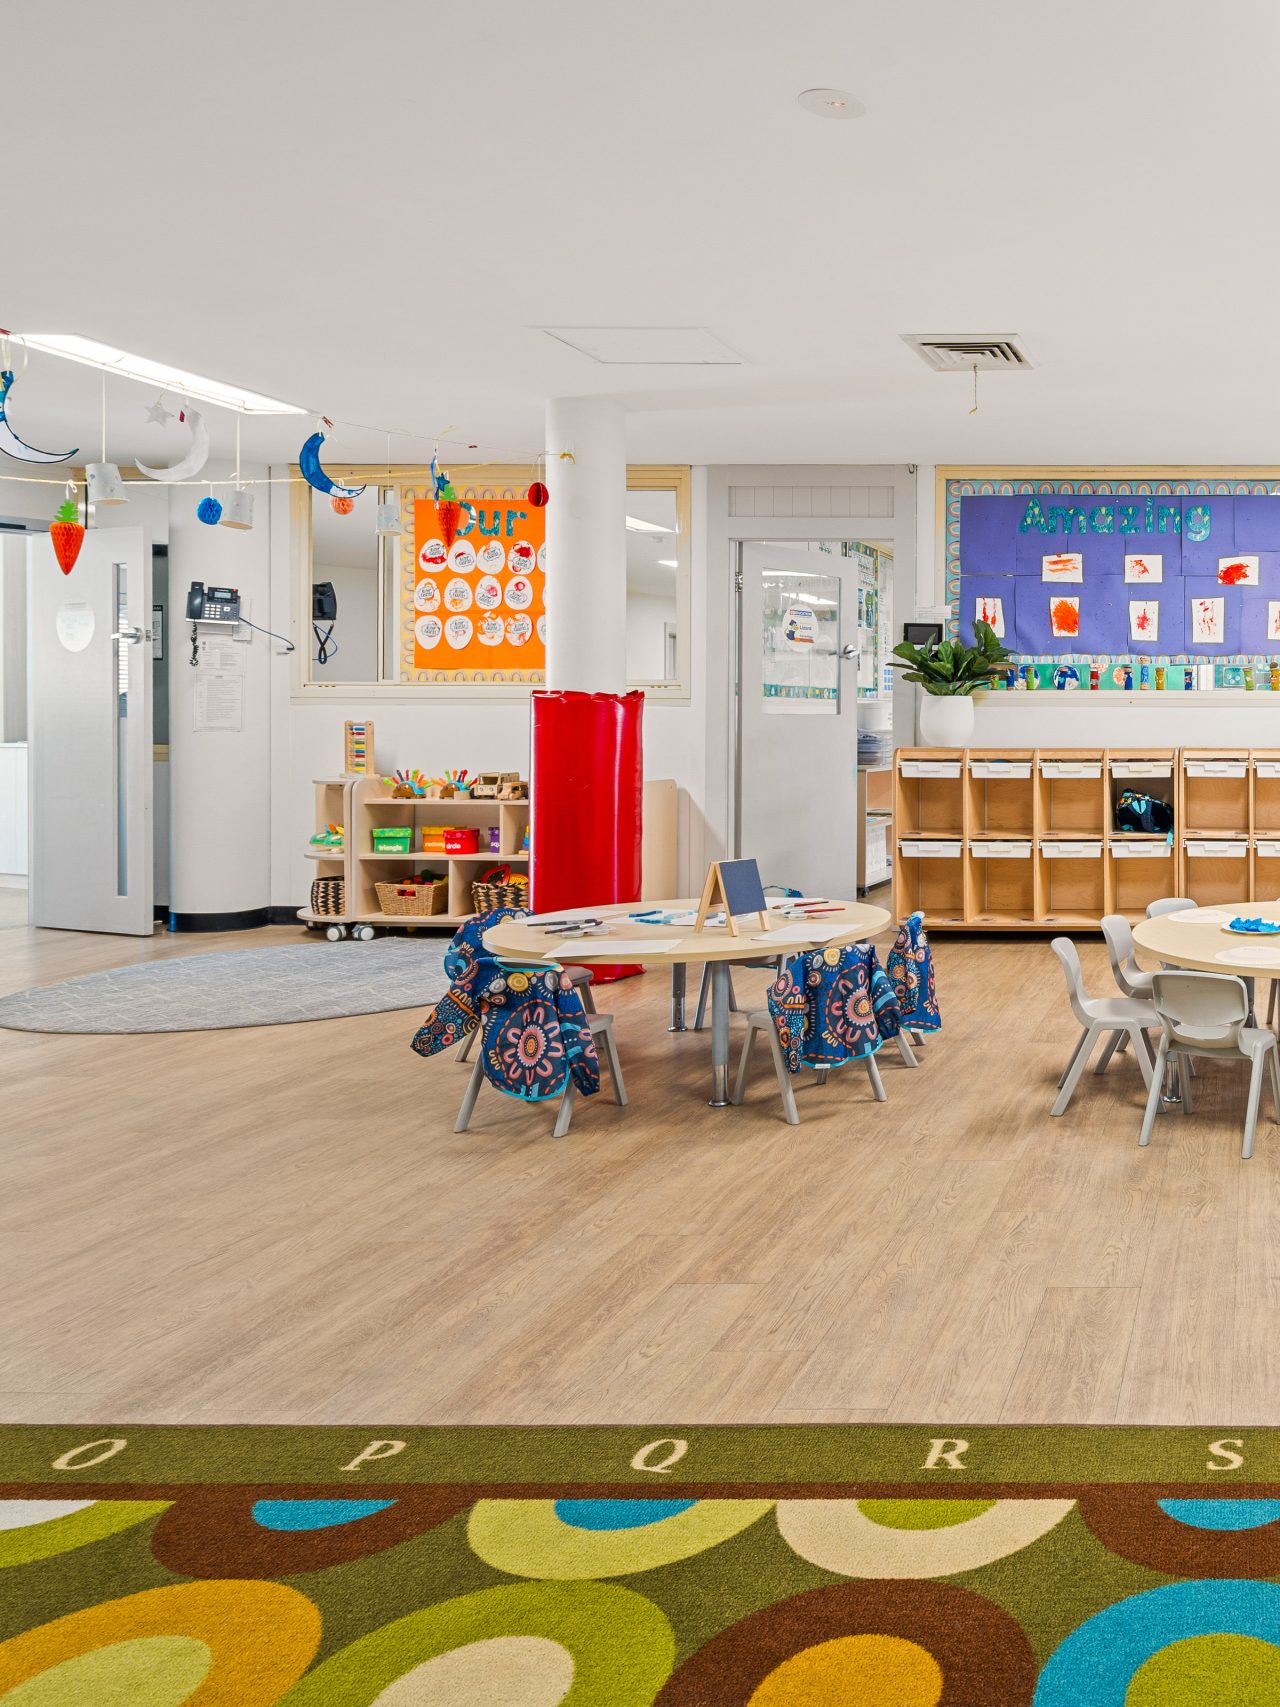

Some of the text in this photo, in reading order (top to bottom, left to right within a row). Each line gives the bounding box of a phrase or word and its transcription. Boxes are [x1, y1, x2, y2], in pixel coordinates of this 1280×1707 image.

[1018, 498, 1211, 542] Amazing
[378, 844, 403, 852] triangle
[52, 1438, 127, 1470] O
[340, 1439, 407, 1471] P
[630, 1438, 688, 1474] Q
[924, 1438, 969, 1470] R
[1206, 1438, 1244, 1471] S
